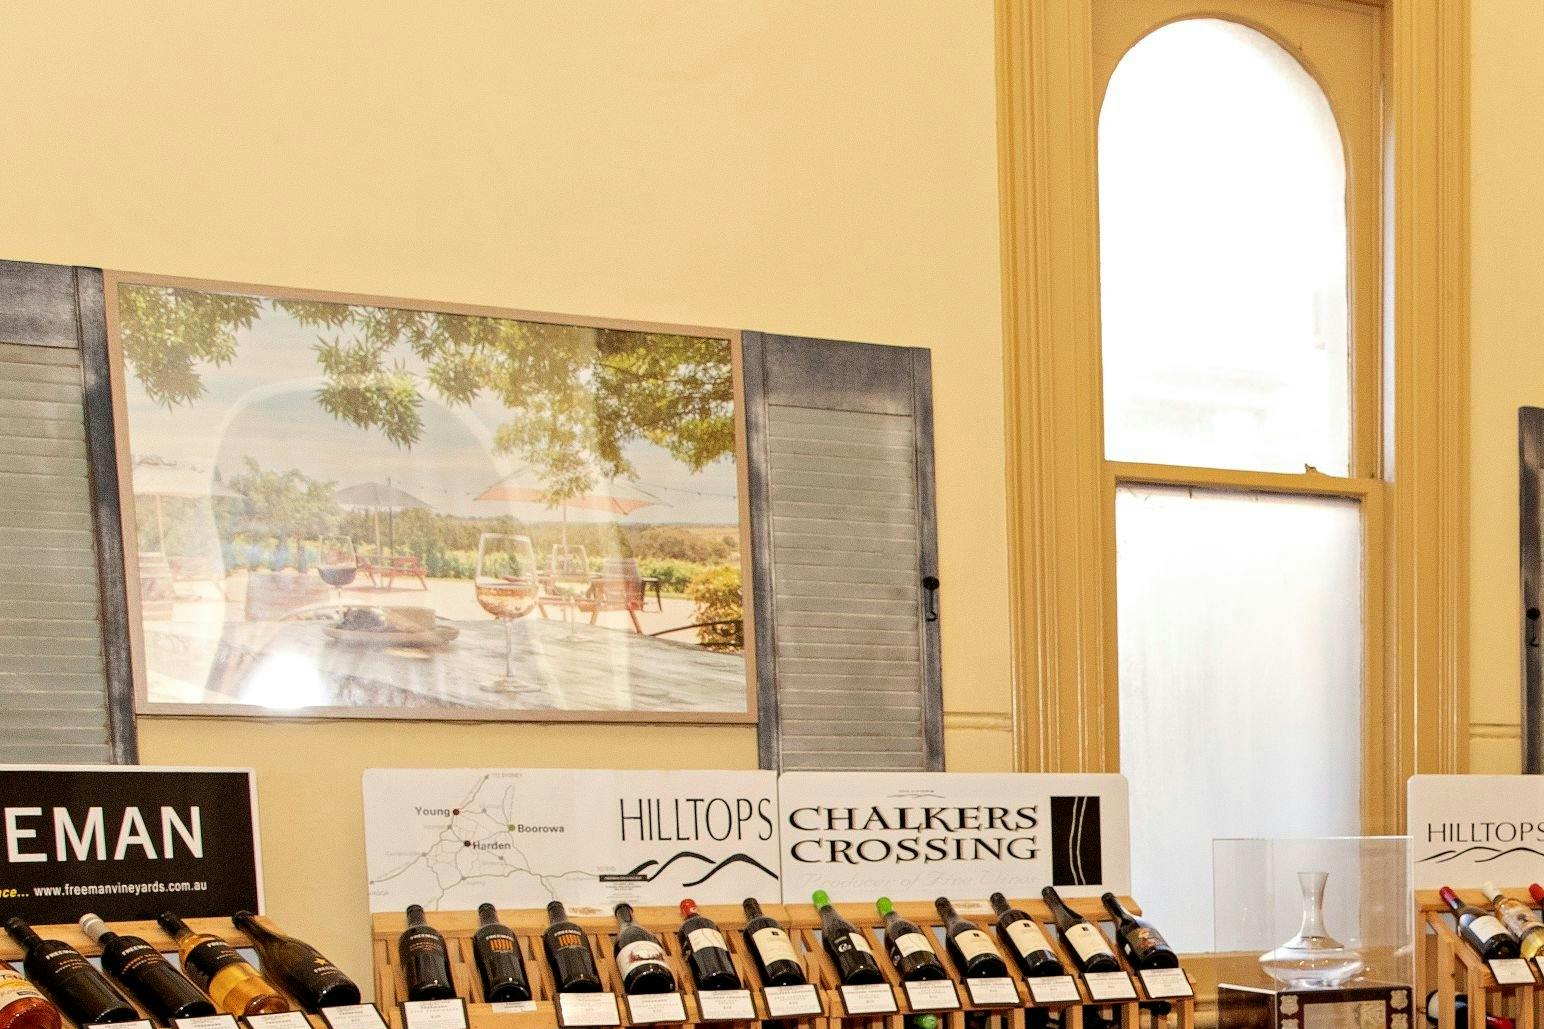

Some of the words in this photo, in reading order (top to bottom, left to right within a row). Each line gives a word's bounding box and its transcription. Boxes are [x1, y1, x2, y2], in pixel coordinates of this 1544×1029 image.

[415, 805, 451, 818] Young
[620, 797, 773, 842] HILLTOPS
[788, 804, 1041, 833] CHALKERS
[4, 805, 205, 863] EMAN
[517, 824, 565, 834] Boorowa
[472, 840, 512, 850] Harden
[790, 835, 1041, 865] CROSSING
[33, 880, 208, 899] www.freemanvineyards.com.au
